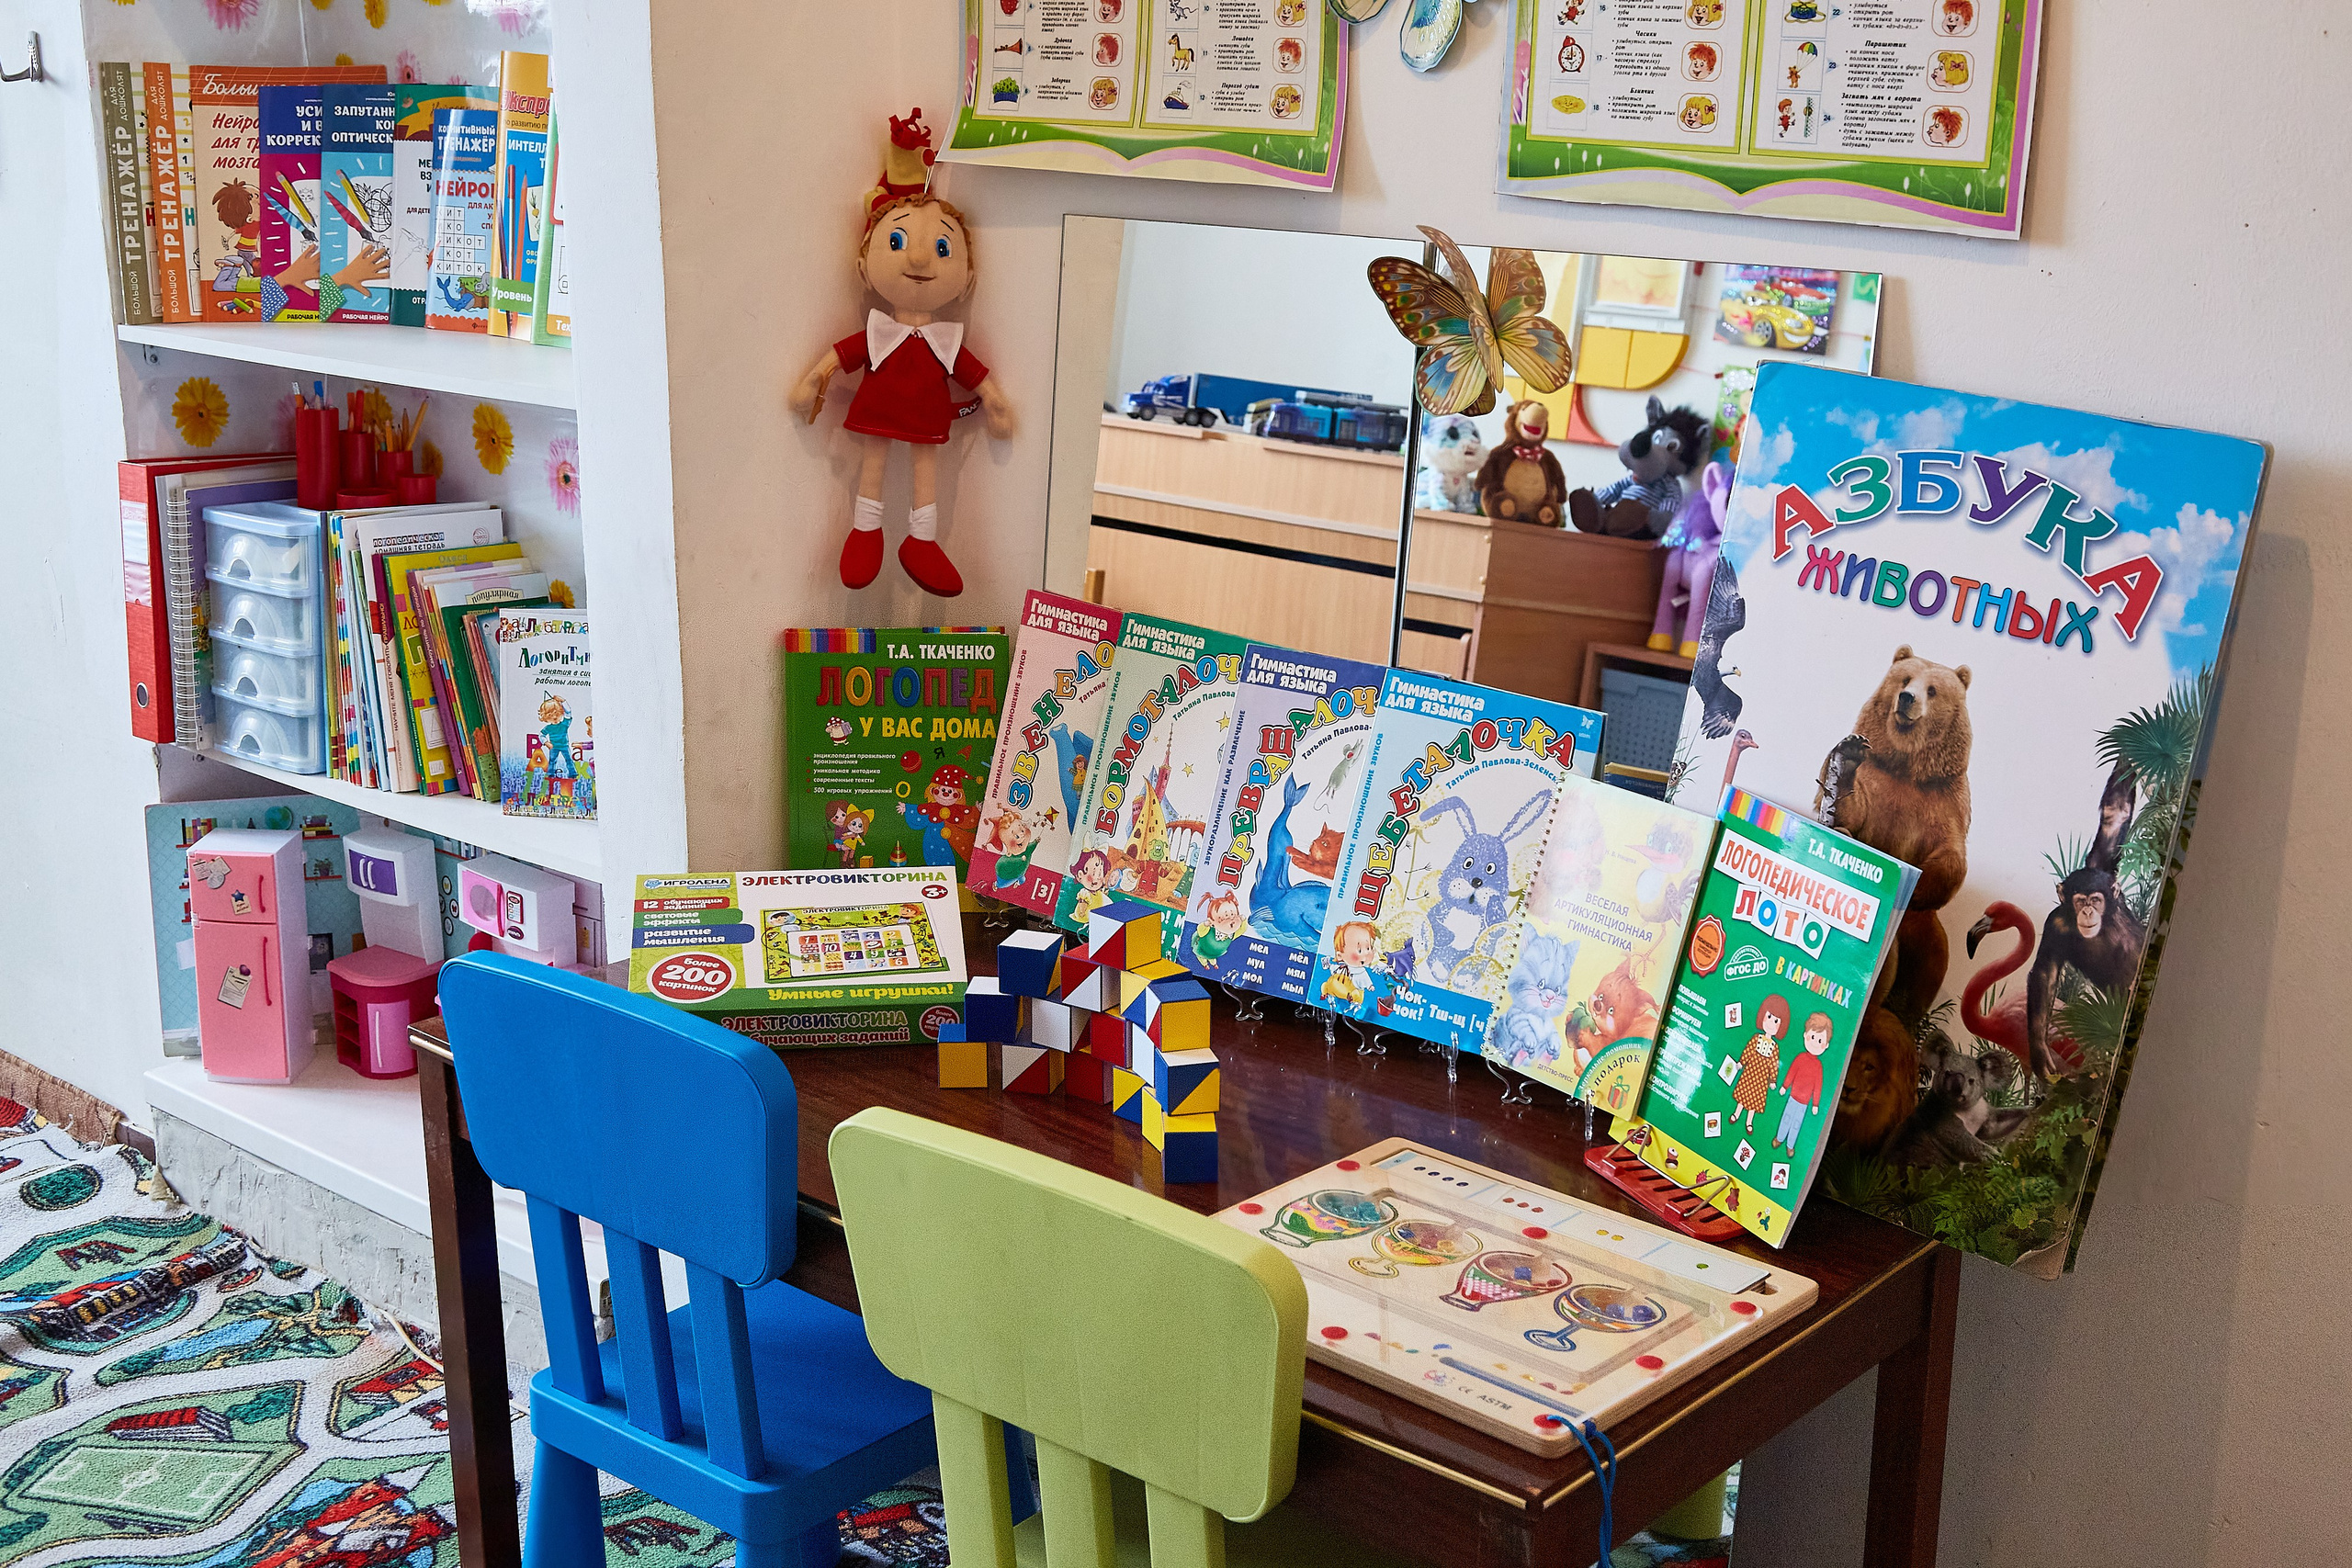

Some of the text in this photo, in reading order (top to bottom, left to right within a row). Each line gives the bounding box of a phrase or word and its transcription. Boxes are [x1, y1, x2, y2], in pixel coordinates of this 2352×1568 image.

[115, 71, 128, 120] ДОШКОЛЯТ
[156, 71, 168, 120] ДОШКОЛЯТ
[301, 120, 311, 130] И
[211, 137, 241, 149] для
[112, 126, 141, 314] БОЛЬШОЙ ТРЕНАЖЁР
[153, 125, 181, 313] БОЛЬШОЙ ТРЕНАЖЁР
[492, 287, 533, 303] Уровень
[1772, 449, 2165, 641] АЗБУКА
[471, 589, 519, 604] популярная
[1797, 544, 2099, 653] ЖИВОТНЫХ
[1030, 598, 1108, 632] Гимнастика
[1026, 614, 1101, 643] для языка
[1126, 618, 1205, 650] Гимнастика
[887, 644, 996, 660] Т.А. ТКАЧЕНКО
[1122, 634, 1196, 661] для языка
[535, 676, 566, 685] работы
[539, 668, 571, 676] занятия
[1250, 653, 1337, 684] Гимнастика
[816, 666, 998, 715] ЛОГОПЕД
[1247, 669, 1328, 696] для языка
[1389, 676, 1486, 713] Гимнастика
[1172, 691, 1236, 722] Татьяна Павлова
[1385, 694, 1475, 724] для языка
[859, 717, 997, 741] У ВАС ДОМА
[992, 649, 1028, 798] ПРАВИЛЬНОЕ ПРОИЗНОШЕНИЕ ЗВУКОВ
[1082, 671, 1122, 825] ПРАВИЛЬНОЕ ПРОИЗНОШЕНИЕ ЗВУКОВ
[1301, 731, 1333, 761] Татьяна
[1204, 788, 1228, 865] ЗВУКОРАЗЛИЧЕНИЕ
[1227, 709, 1246, 766] РАЗВЛЕЧЕНИЕ
[1445, 764, 1481, 790] Татьяна
[1338, 732, 1385, 899] ПРАВИЛЬНОЕ ПРОИЗНОШЕНИЕ ЗВУКОВ
[1353, 716, 1577, 920] ЩЕБЕТАЛОЧКА
[1807, 838, 1883, 884] Т.А. ТКАЧЕНКО
[741, 871, 948, 886] ЭЛЕКТРОВИКТОРИНА
[1721, 840, 1871, 931] ЛОГОПЕДИЧЕСКОЕ
[643, 900, 659, 909] 12
[924, 887, 946, 898] 3+
[1585, 892, 1630, 917] ВЕСЕЛАЯ
[643, 911, 699, 919] световые
[643, 918, 701, 927] эффекты
[802, 905, 889, 914] ЭЛЕКТРОВИКТОРИНА
[1554, 898, 1653, 942] АРТИКУЛЯЦИОННАЯ
[1736, 889, 1824, 950] ЛОТО
[644, 928, 712, 939] развитие
[644, 935, 726, 946] мышления
[1567, 919, 1633, 952] ГИМНАСТИКА
[1249, 942, 1269, 955] мел
[1288, 952, 1309, 965] мёл
[662, 964, 727, 986] 200
[1246, 957, 1265, 970] мул
[1285, 967, 1306, 980] мял
[1726, 961, 1766, 976] ФГОС ДО
[658, 981, 718, 993] картинок
[1242, 971, 1263, 985] мол
[1281, 981, 1304, 996] мыл
[1775, 955, 1853, 1009] В КАРТИНКАХ
[768, 984, 955, 1001] Умные игрушки!
[840, 1028, 910, 1043] заданий
[1594, 1054, 1641, 1087] подарок
